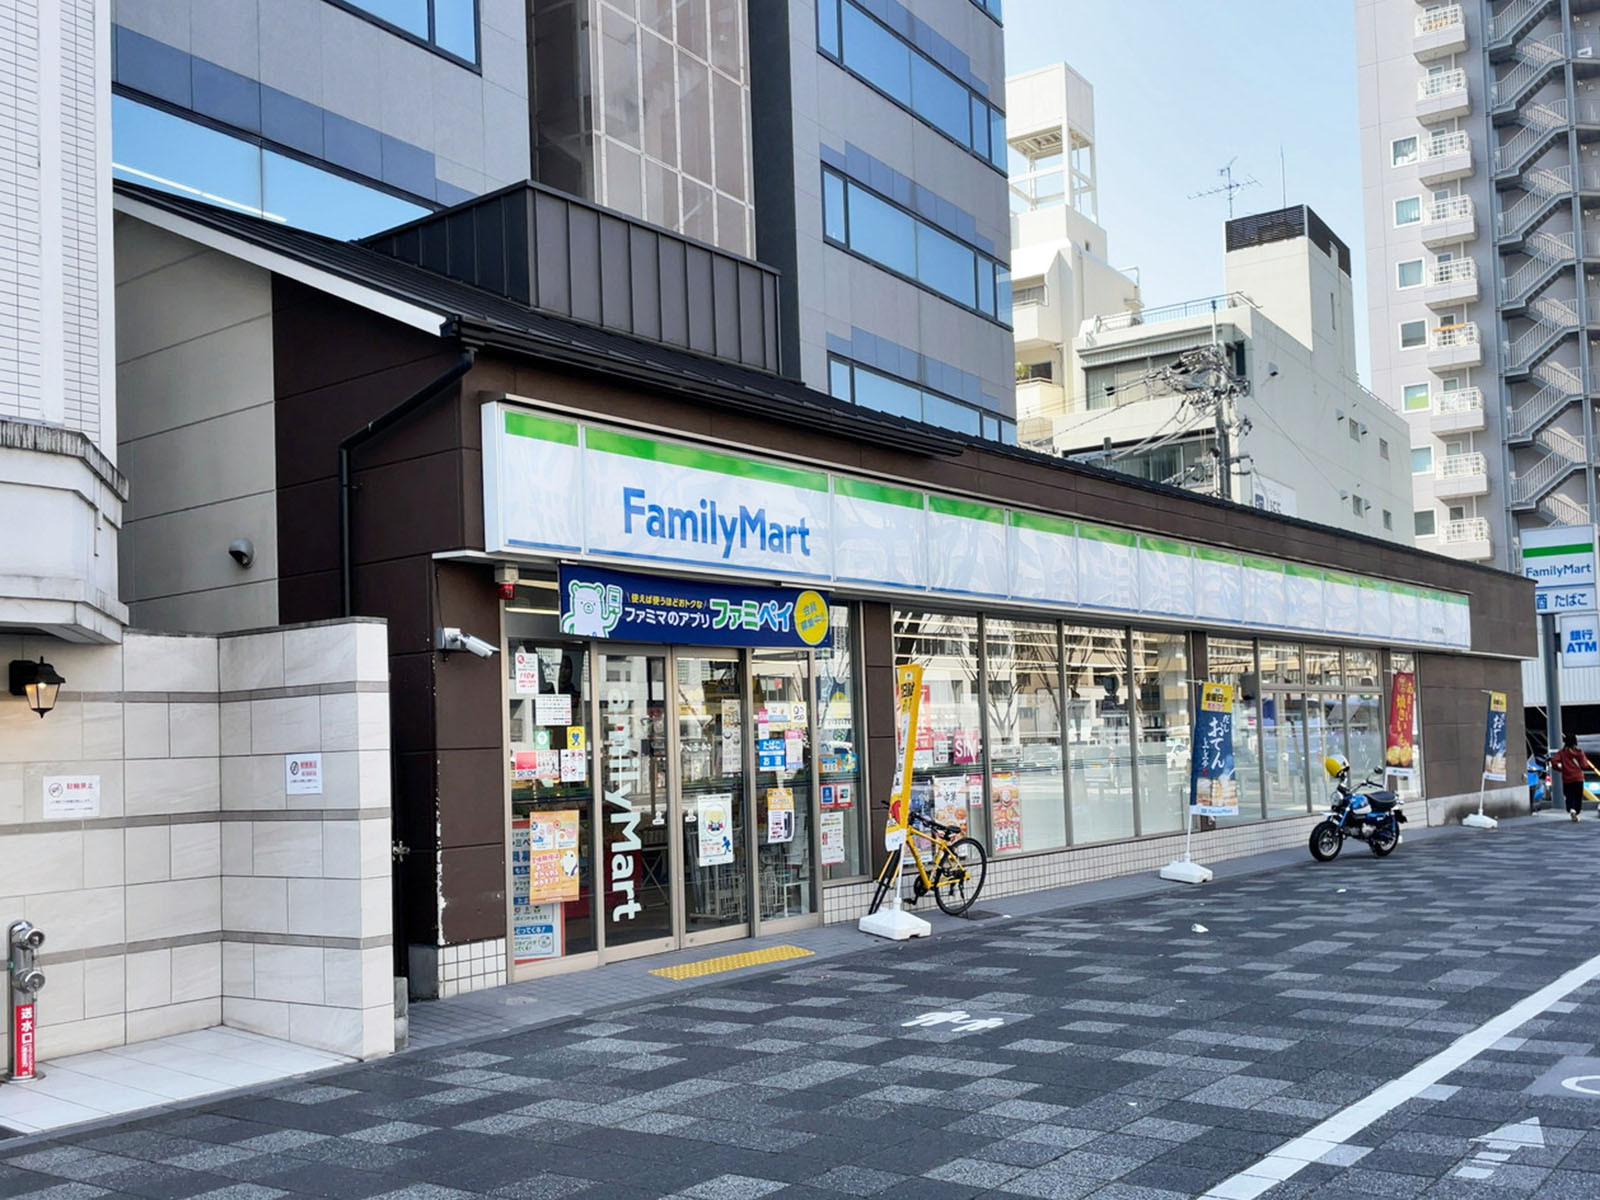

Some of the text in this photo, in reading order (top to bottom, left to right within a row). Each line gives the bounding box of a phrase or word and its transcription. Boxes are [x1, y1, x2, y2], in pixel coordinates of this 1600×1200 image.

[623, 486, 811, 559] FamilyMart
[1526, 564, 1592, 578] FamilyMart
[1554, 593, 1588, 607] たばこ
[624, 607, 710, 628] ファミマのアプリ
[710, 598, 793, 632] ファミペイ
[1570, 629, 1593, 640] 銀行
[1566, 641, 1597, 654] ATM
[604, 688, 643, 922] amilyMart
[20, 1007, 33, 1044] 送水口
